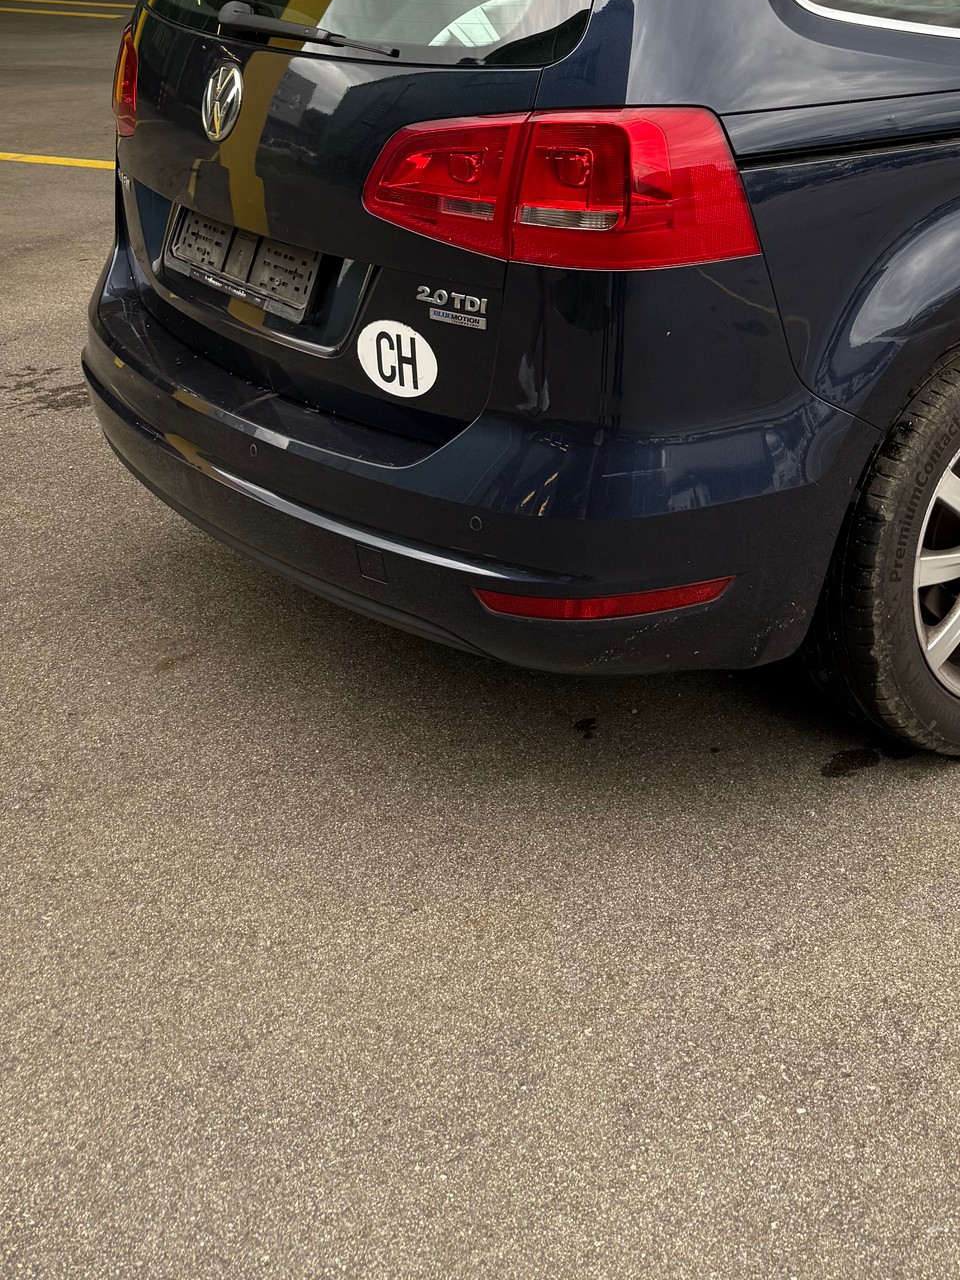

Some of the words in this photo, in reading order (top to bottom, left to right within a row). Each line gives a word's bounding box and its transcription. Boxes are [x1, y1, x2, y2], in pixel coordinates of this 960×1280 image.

[416, 285, 448, 306] 2.0
[451, 292, 488, 314] TDI
[375, 330, 419, 390] CH
